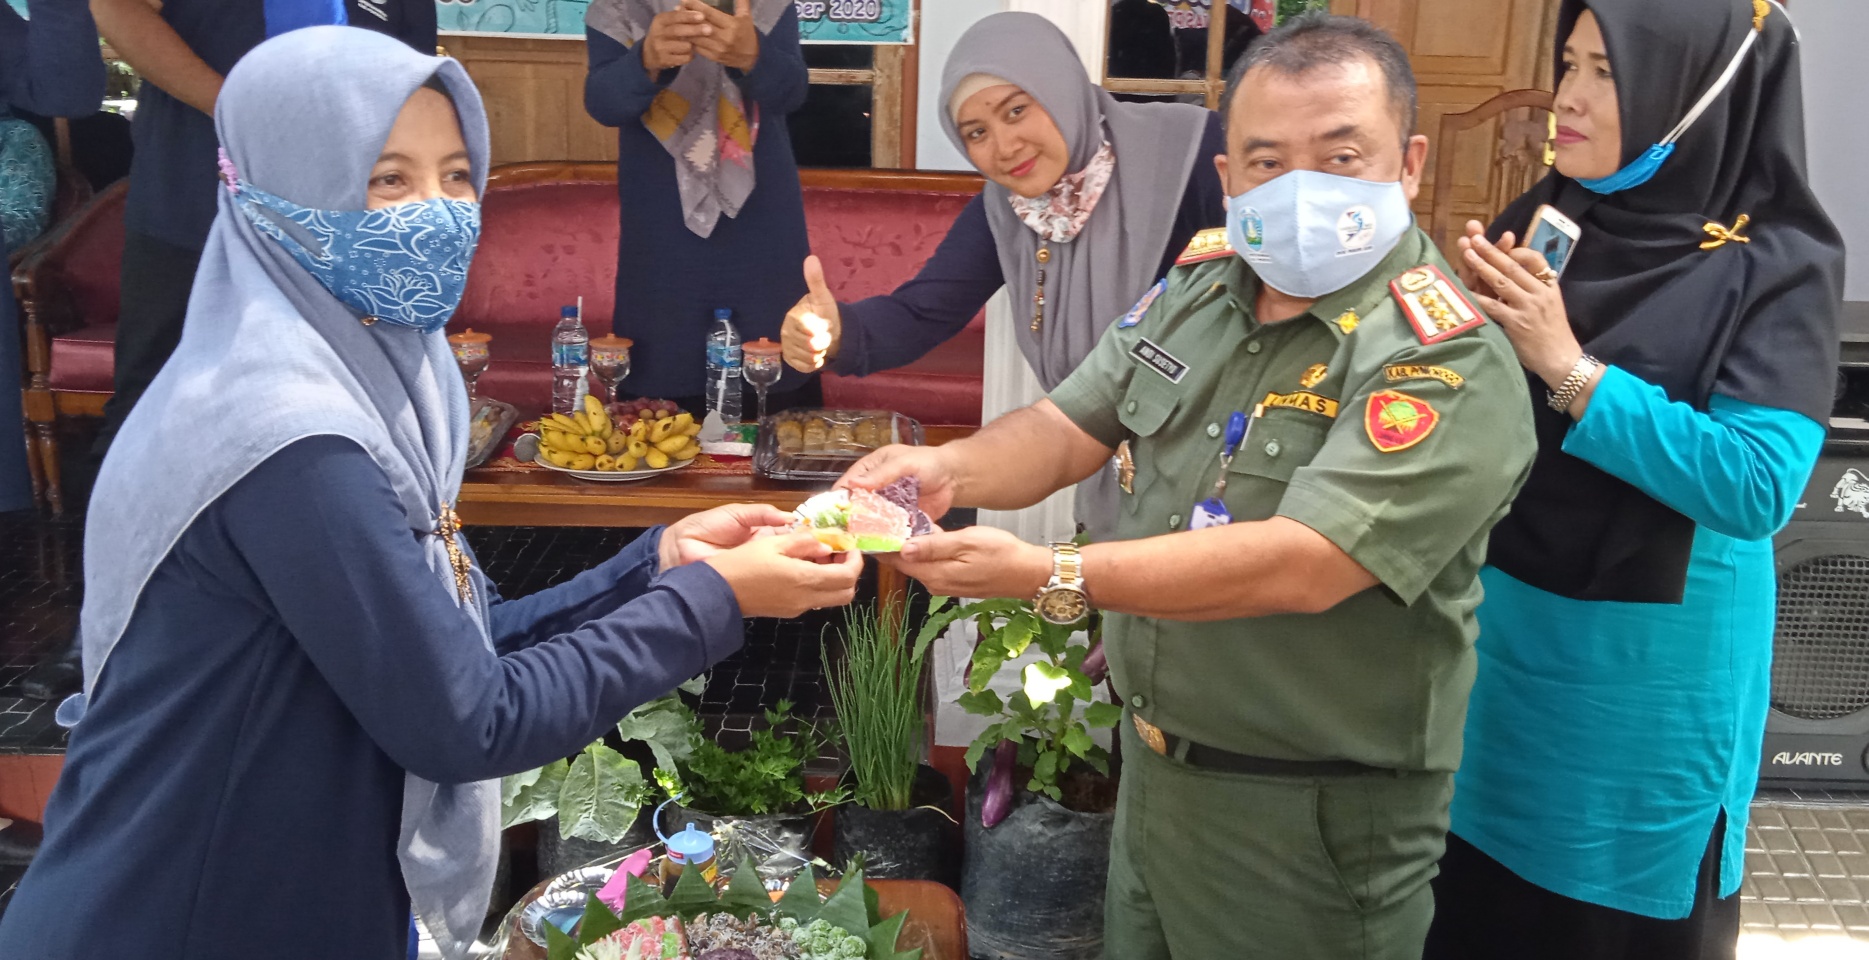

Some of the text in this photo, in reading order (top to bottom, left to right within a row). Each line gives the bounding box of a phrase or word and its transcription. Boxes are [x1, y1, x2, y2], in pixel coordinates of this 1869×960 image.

[830, 0, 879, 19] 2020
[1269, 395, 1326, 412] LMAS
[1772, 752, 1843, 765] AVANTE
